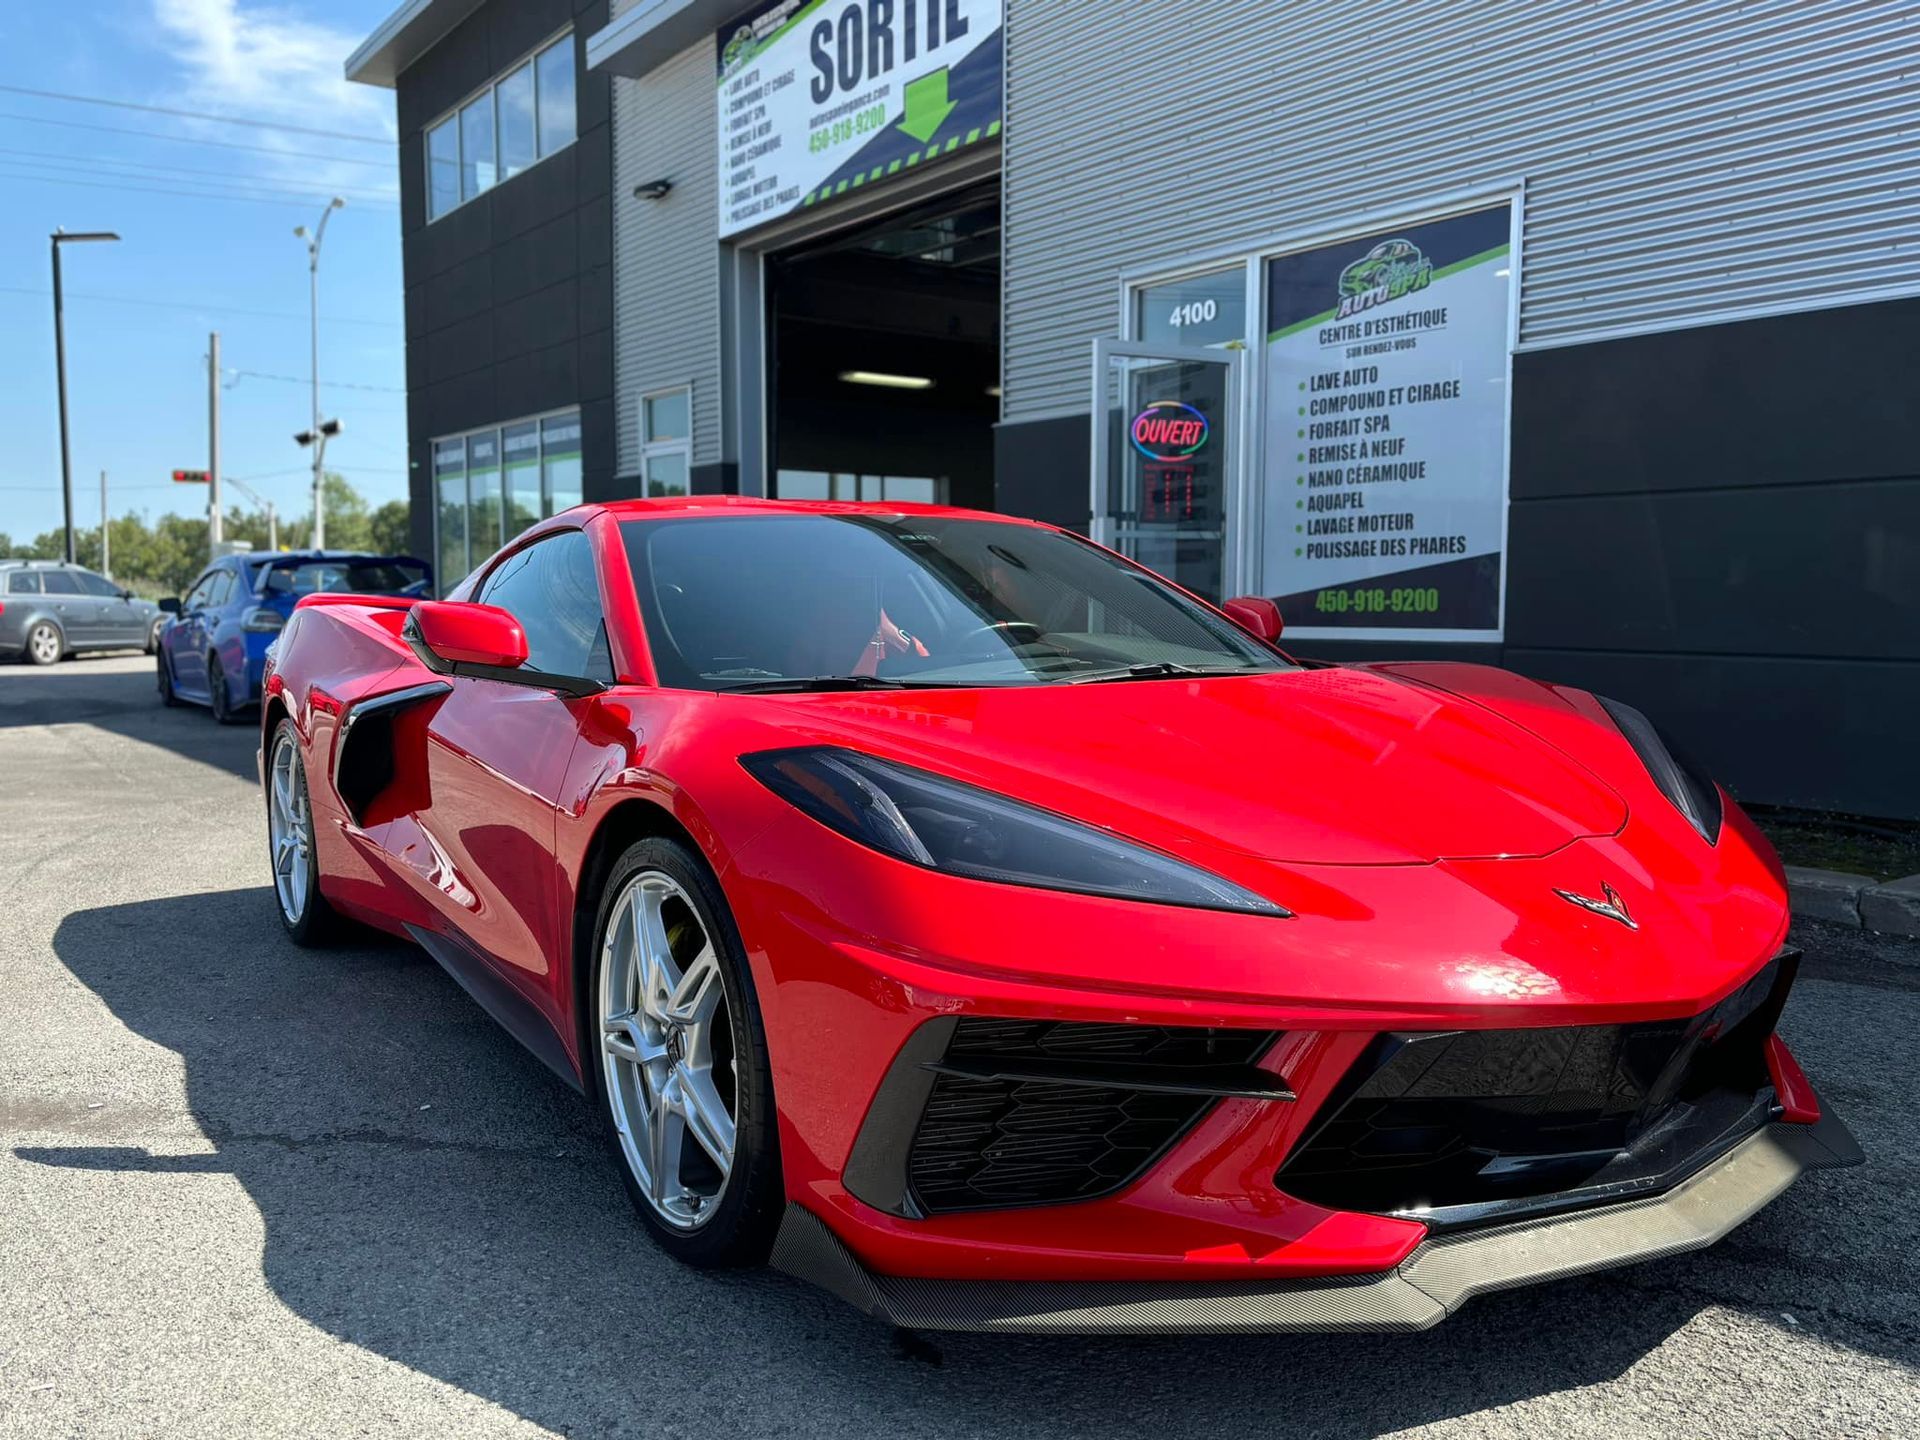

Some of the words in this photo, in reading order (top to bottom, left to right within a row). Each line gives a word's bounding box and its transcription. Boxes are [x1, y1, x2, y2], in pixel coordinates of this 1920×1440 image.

[1169, 299, 1217, 327] 4100
[1319, 323, 1363, 345] CENTRE
[1364, 307, 1448, 336] D'ESTHÉTIQUE
[1346, 345, 1362, 359] SUR
[1363, 337, 1417, 356] RENDEZ-VOUS
[1310, 370, 1340, 392] LAVE
[1343, 366, 1378, 388] AUTO
[1310, 389, 1386, 417] COMPOUND
[1389, 387, 1404, 406] ET
[1407, 380, 1460, 404] CIRAGE
[1135, 418, 1203, 445] OUVERT
[1309, 418, 1361, 441] FORFAIT
[1364, 414, 1390, 434] SPA
[1309, 443, 1357, 464] REMISE
[1359, 438, 1369, 459] À
[1371, 438, 1406, 458] NEUF
[1308, 468, 1343, 489] NANO
[1346, 462, 1426, 485] CÉRAMIQUE
[1307, 491, 1364, 513] AQUAPEL
[1307, 516, 1354, 536] LAVAGE
[1357, 513, 1414, 533] MOTEUR
[1306, 539, 1377, 560] POLISSAGE
[1380, 537, 1407, 557] DES
[1410, 535, 1467, 556] PHARES
[1315, 587, 1439, 613] 450-918-9200
